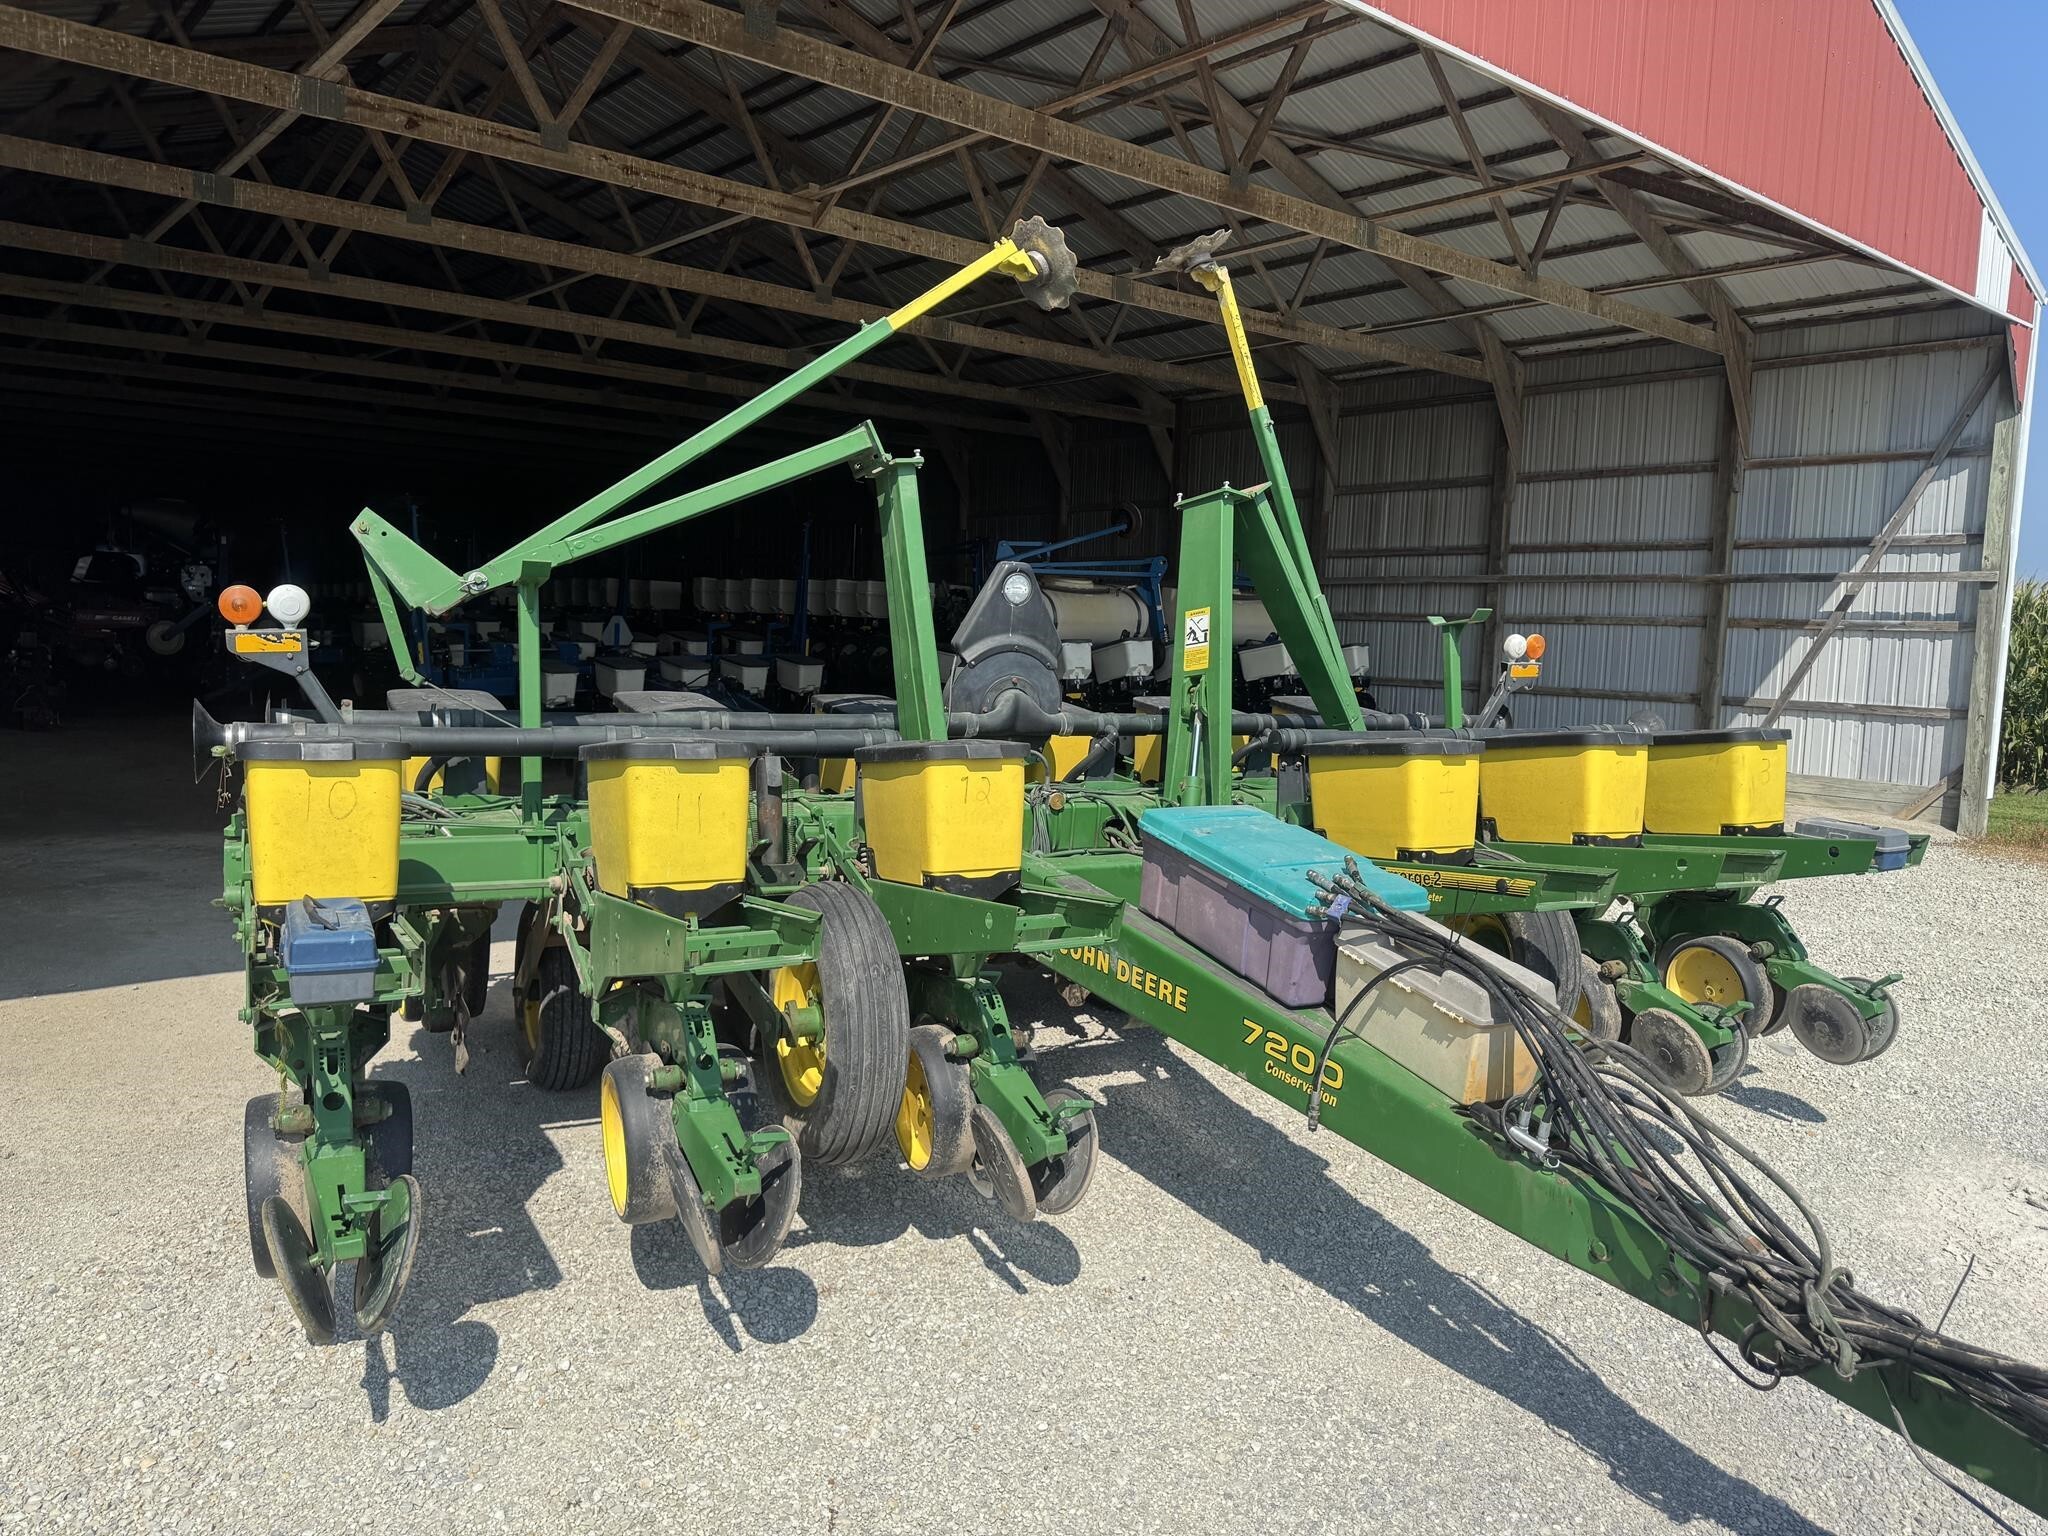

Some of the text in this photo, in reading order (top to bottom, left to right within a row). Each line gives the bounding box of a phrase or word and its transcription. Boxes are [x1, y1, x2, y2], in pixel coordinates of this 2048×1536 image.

[306, 778, 358, 822] 10
[961, 775, 991, 805] 12
[1116, 958, 1189, 1013] DEERE
[1243, 1017, 1344, 1090] 7200
[1264, 1060, 1338, 1107] Conservaion
